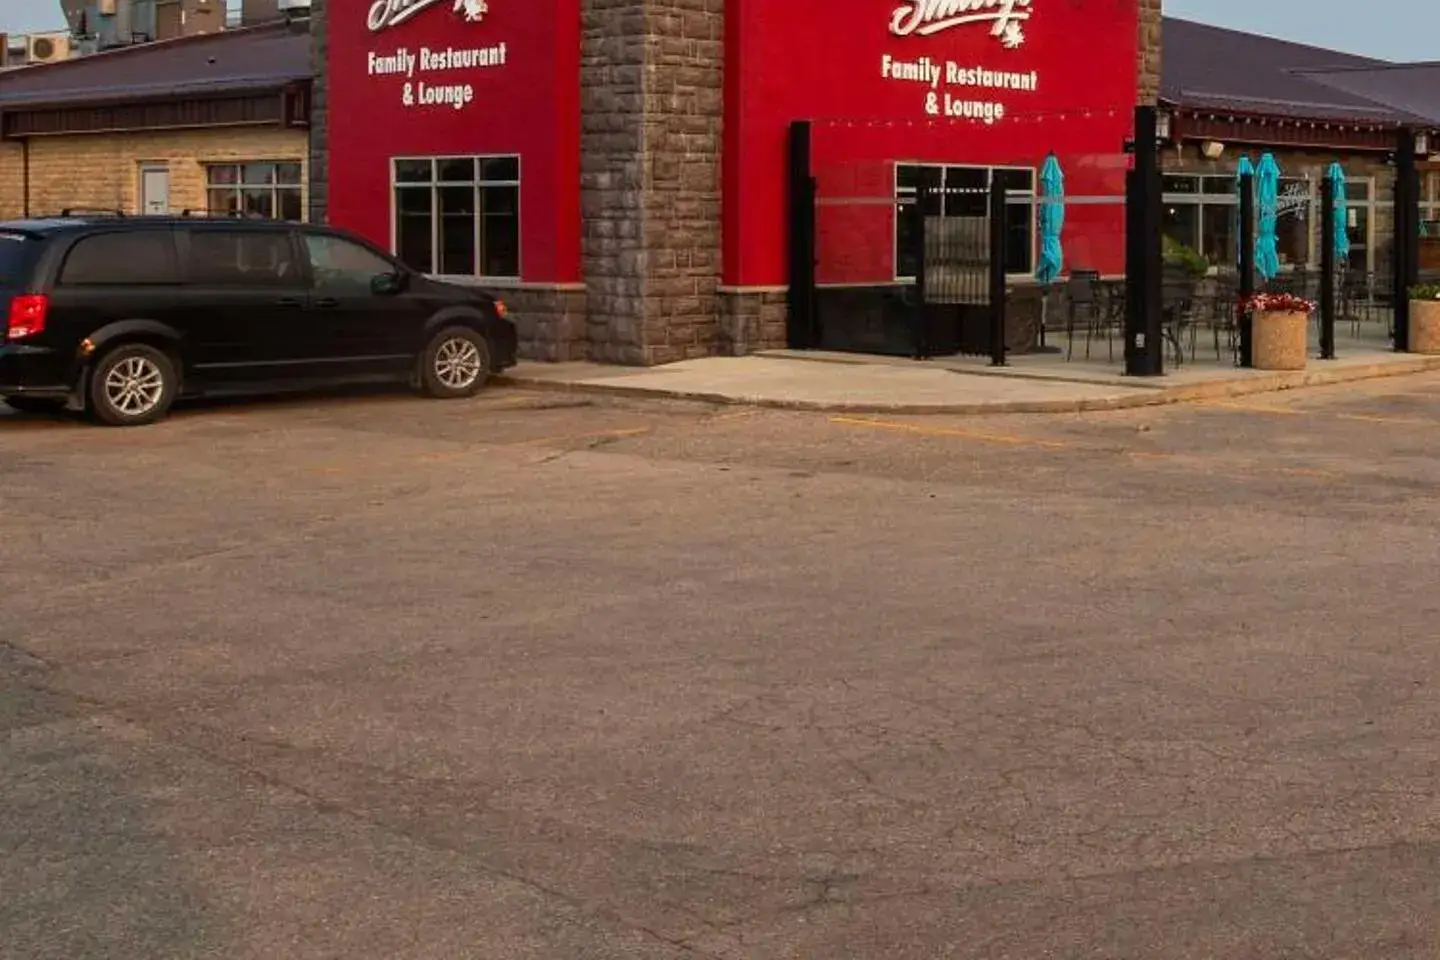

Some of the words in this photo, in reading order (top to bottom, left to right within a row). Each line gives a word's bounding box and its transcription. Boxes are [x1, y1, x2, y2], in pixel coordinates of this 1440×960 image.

[368, 48, 415, 78] Family
[420, 42, 506, 70] Restaurant
[882, 55, 941, 88] Family
[946, 61, 1037, 91] Restaurant
[402, 82, 414, 106] &
[418, 81, 473, 109] Lounge
[925, 91, 938, 115] &
[944, 93, 1004, 124] Lounge
